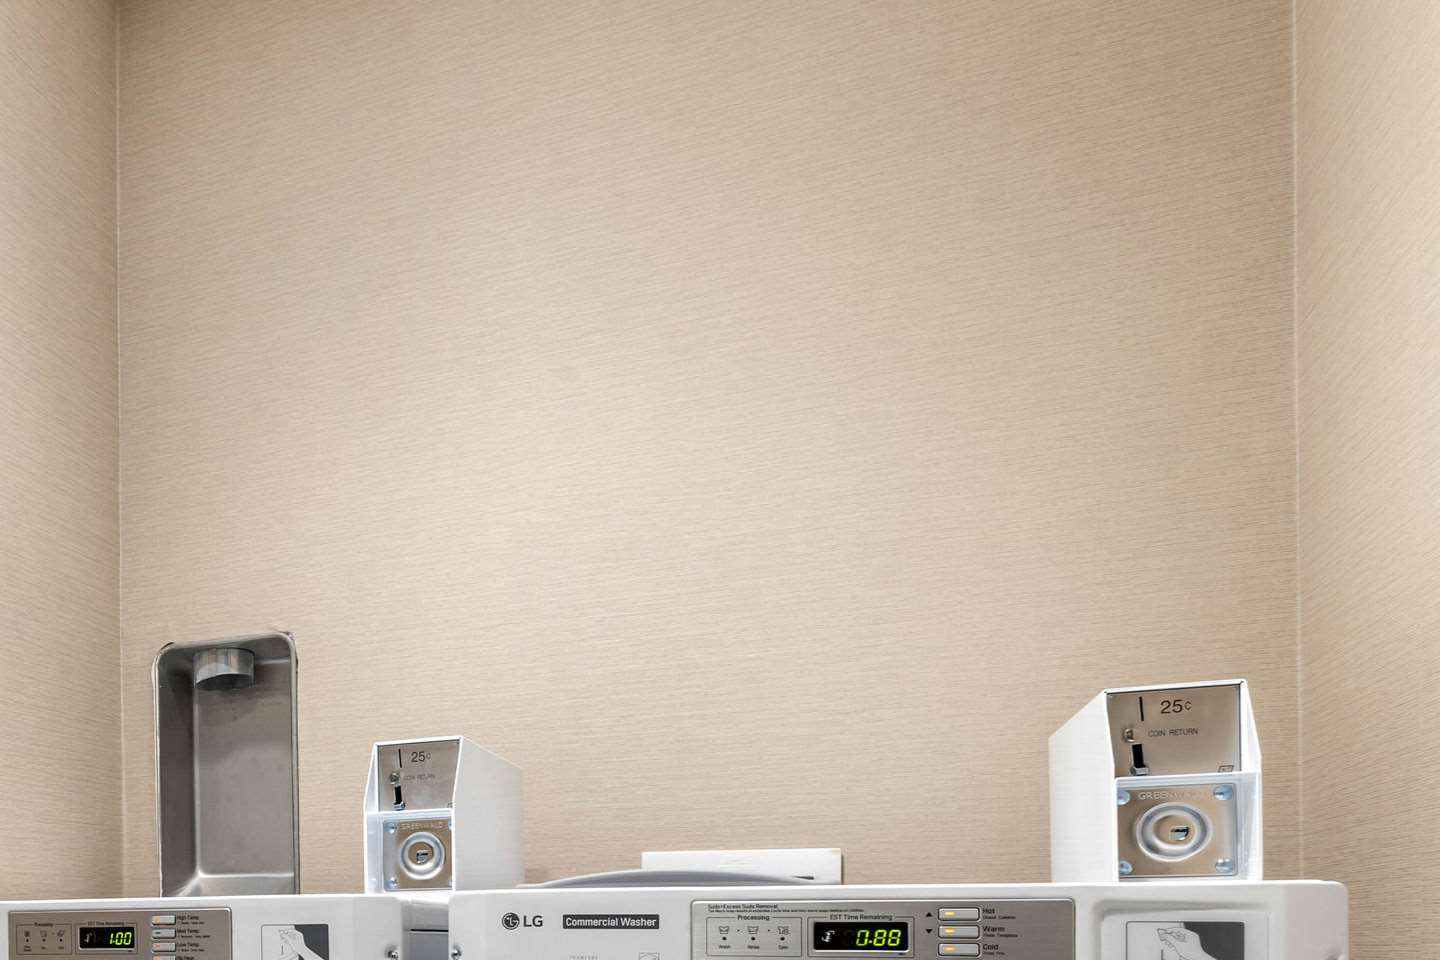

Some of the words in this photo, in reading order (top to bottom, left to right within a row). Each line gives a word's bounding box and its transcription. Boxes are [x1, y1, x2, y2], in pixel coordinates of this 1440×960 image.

[1169, 728, 1199, 736] RETURN
[523, 915, 543, 928] LG
[565, 917, 619, 927] Commercial
[621, 918, 657, 927] Washer
